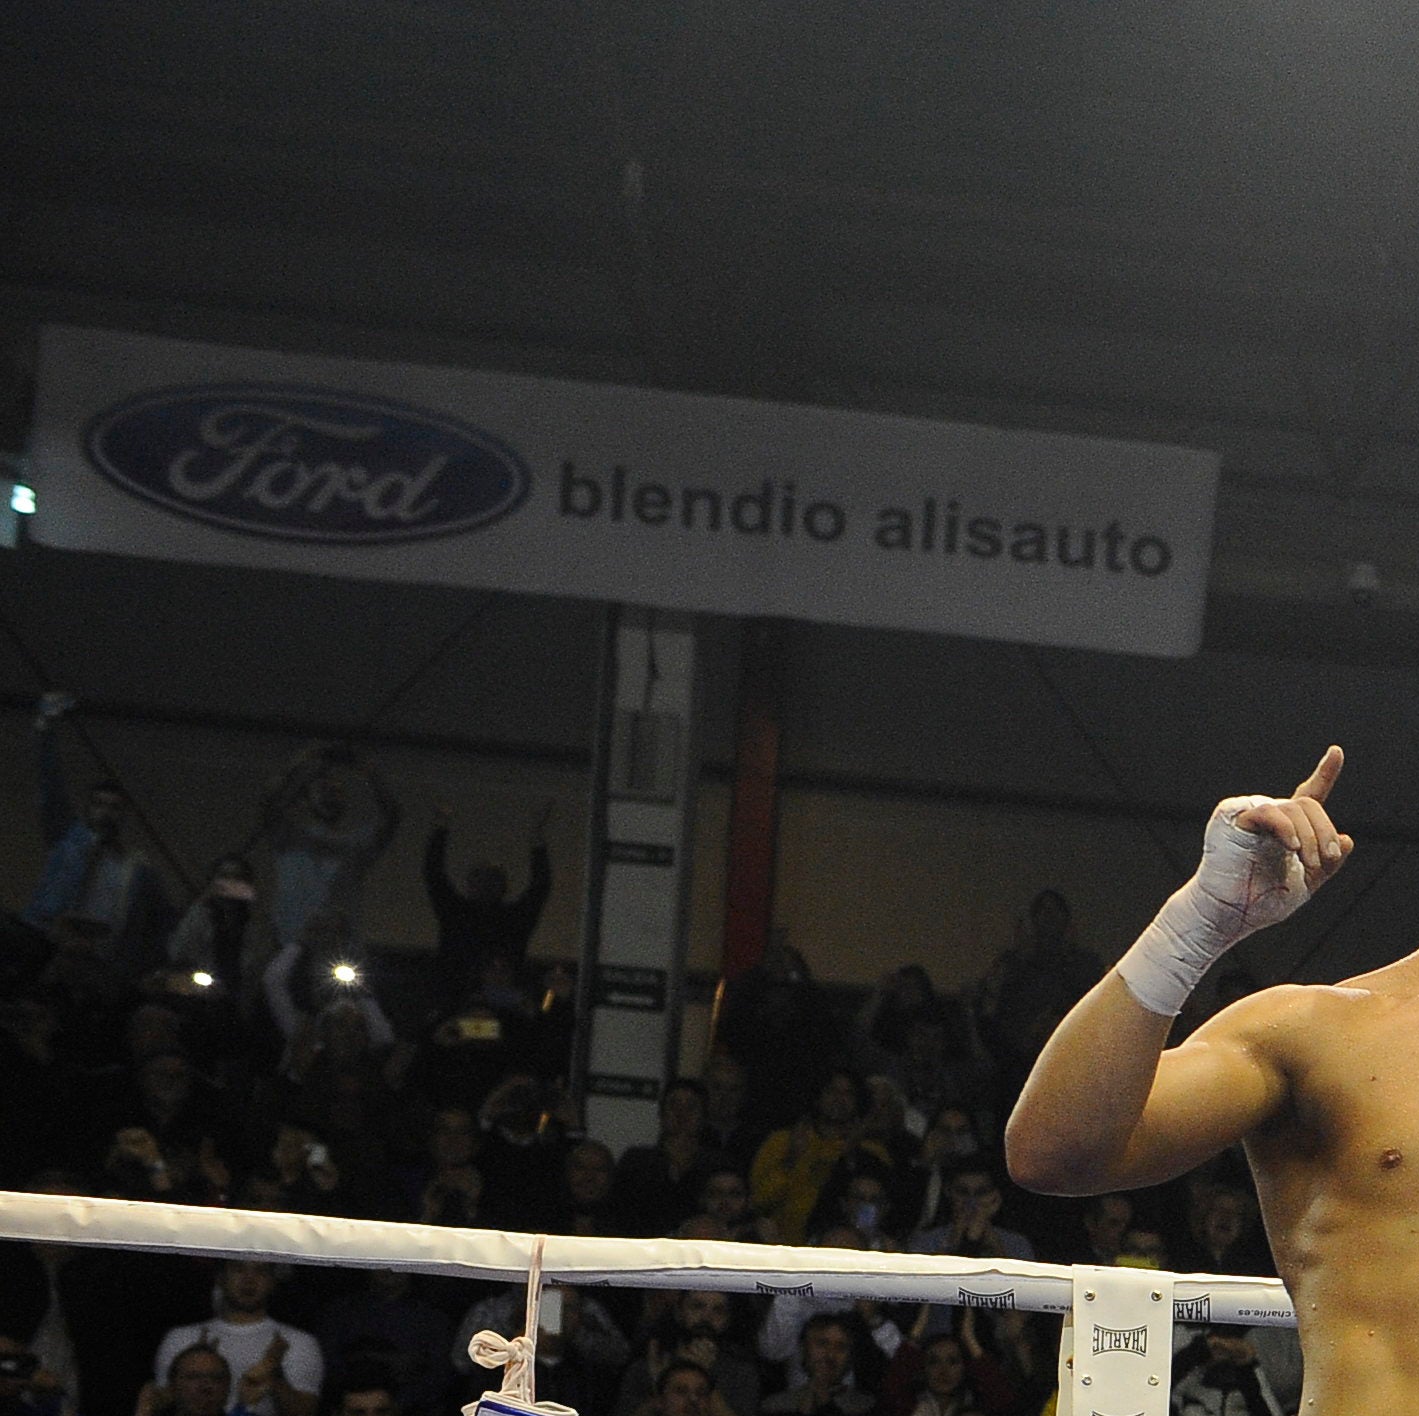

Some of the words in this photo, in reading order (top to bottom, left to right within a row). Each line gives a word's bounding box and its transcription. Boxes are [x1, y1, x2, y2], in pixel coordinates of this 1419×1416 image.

[168, 402, 450, 518] Ford
[558, 460, 847, 541] blendio
[874, 498, 1172, 578] alisauto
[1093, 1324, 1147, 1356] CHARLIE
